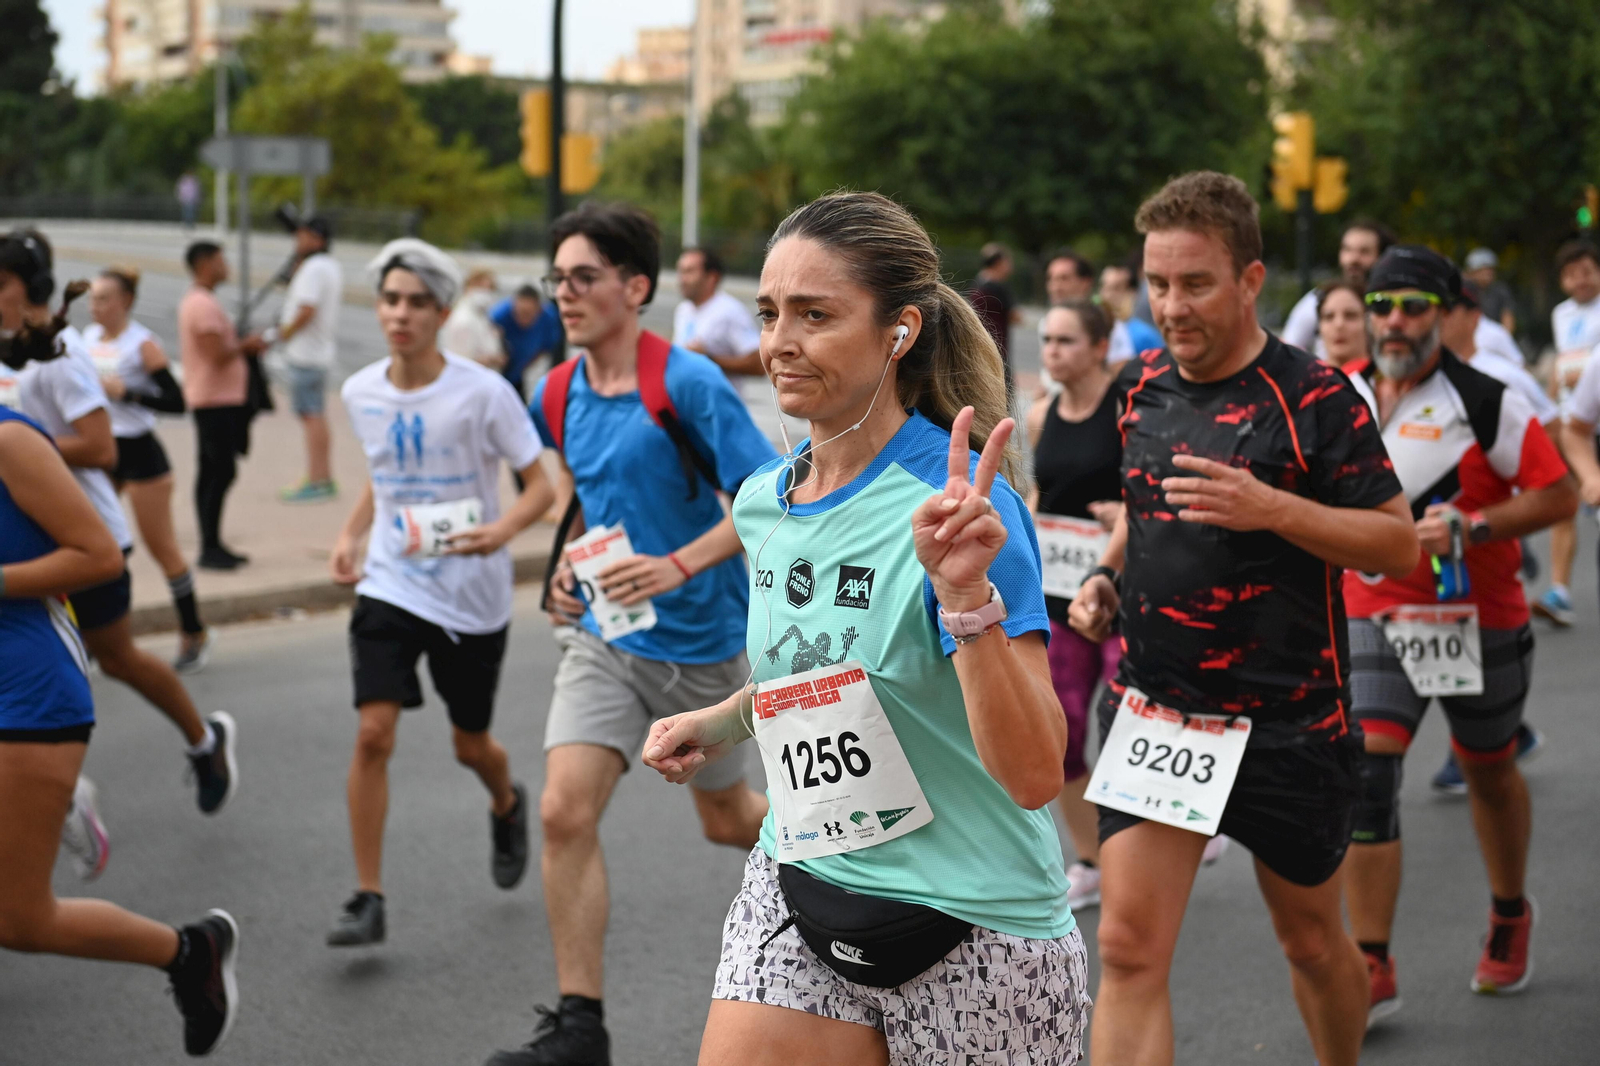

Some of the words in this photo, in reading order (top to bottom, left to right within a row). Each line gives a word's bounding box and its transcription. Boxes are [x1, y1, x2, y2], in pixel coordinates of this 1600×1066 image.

[789, 580, 809, 597] FRENO
[791, 570, 812, 588] PONLE
[837, 578, 870, 600] AXA
[835, 598, 868, 608] fundación
[753, 691, 777, 720] 42
[769, 681, 813, 703] CARRERA
[812, 668, 866, 692] URBANA
[781, 731, 871, 790] 1256
[1127, 738, 1216, 784] 9203
[795, 831, 819, 841] málaga
[836, 940, 864, 961] NIKE
